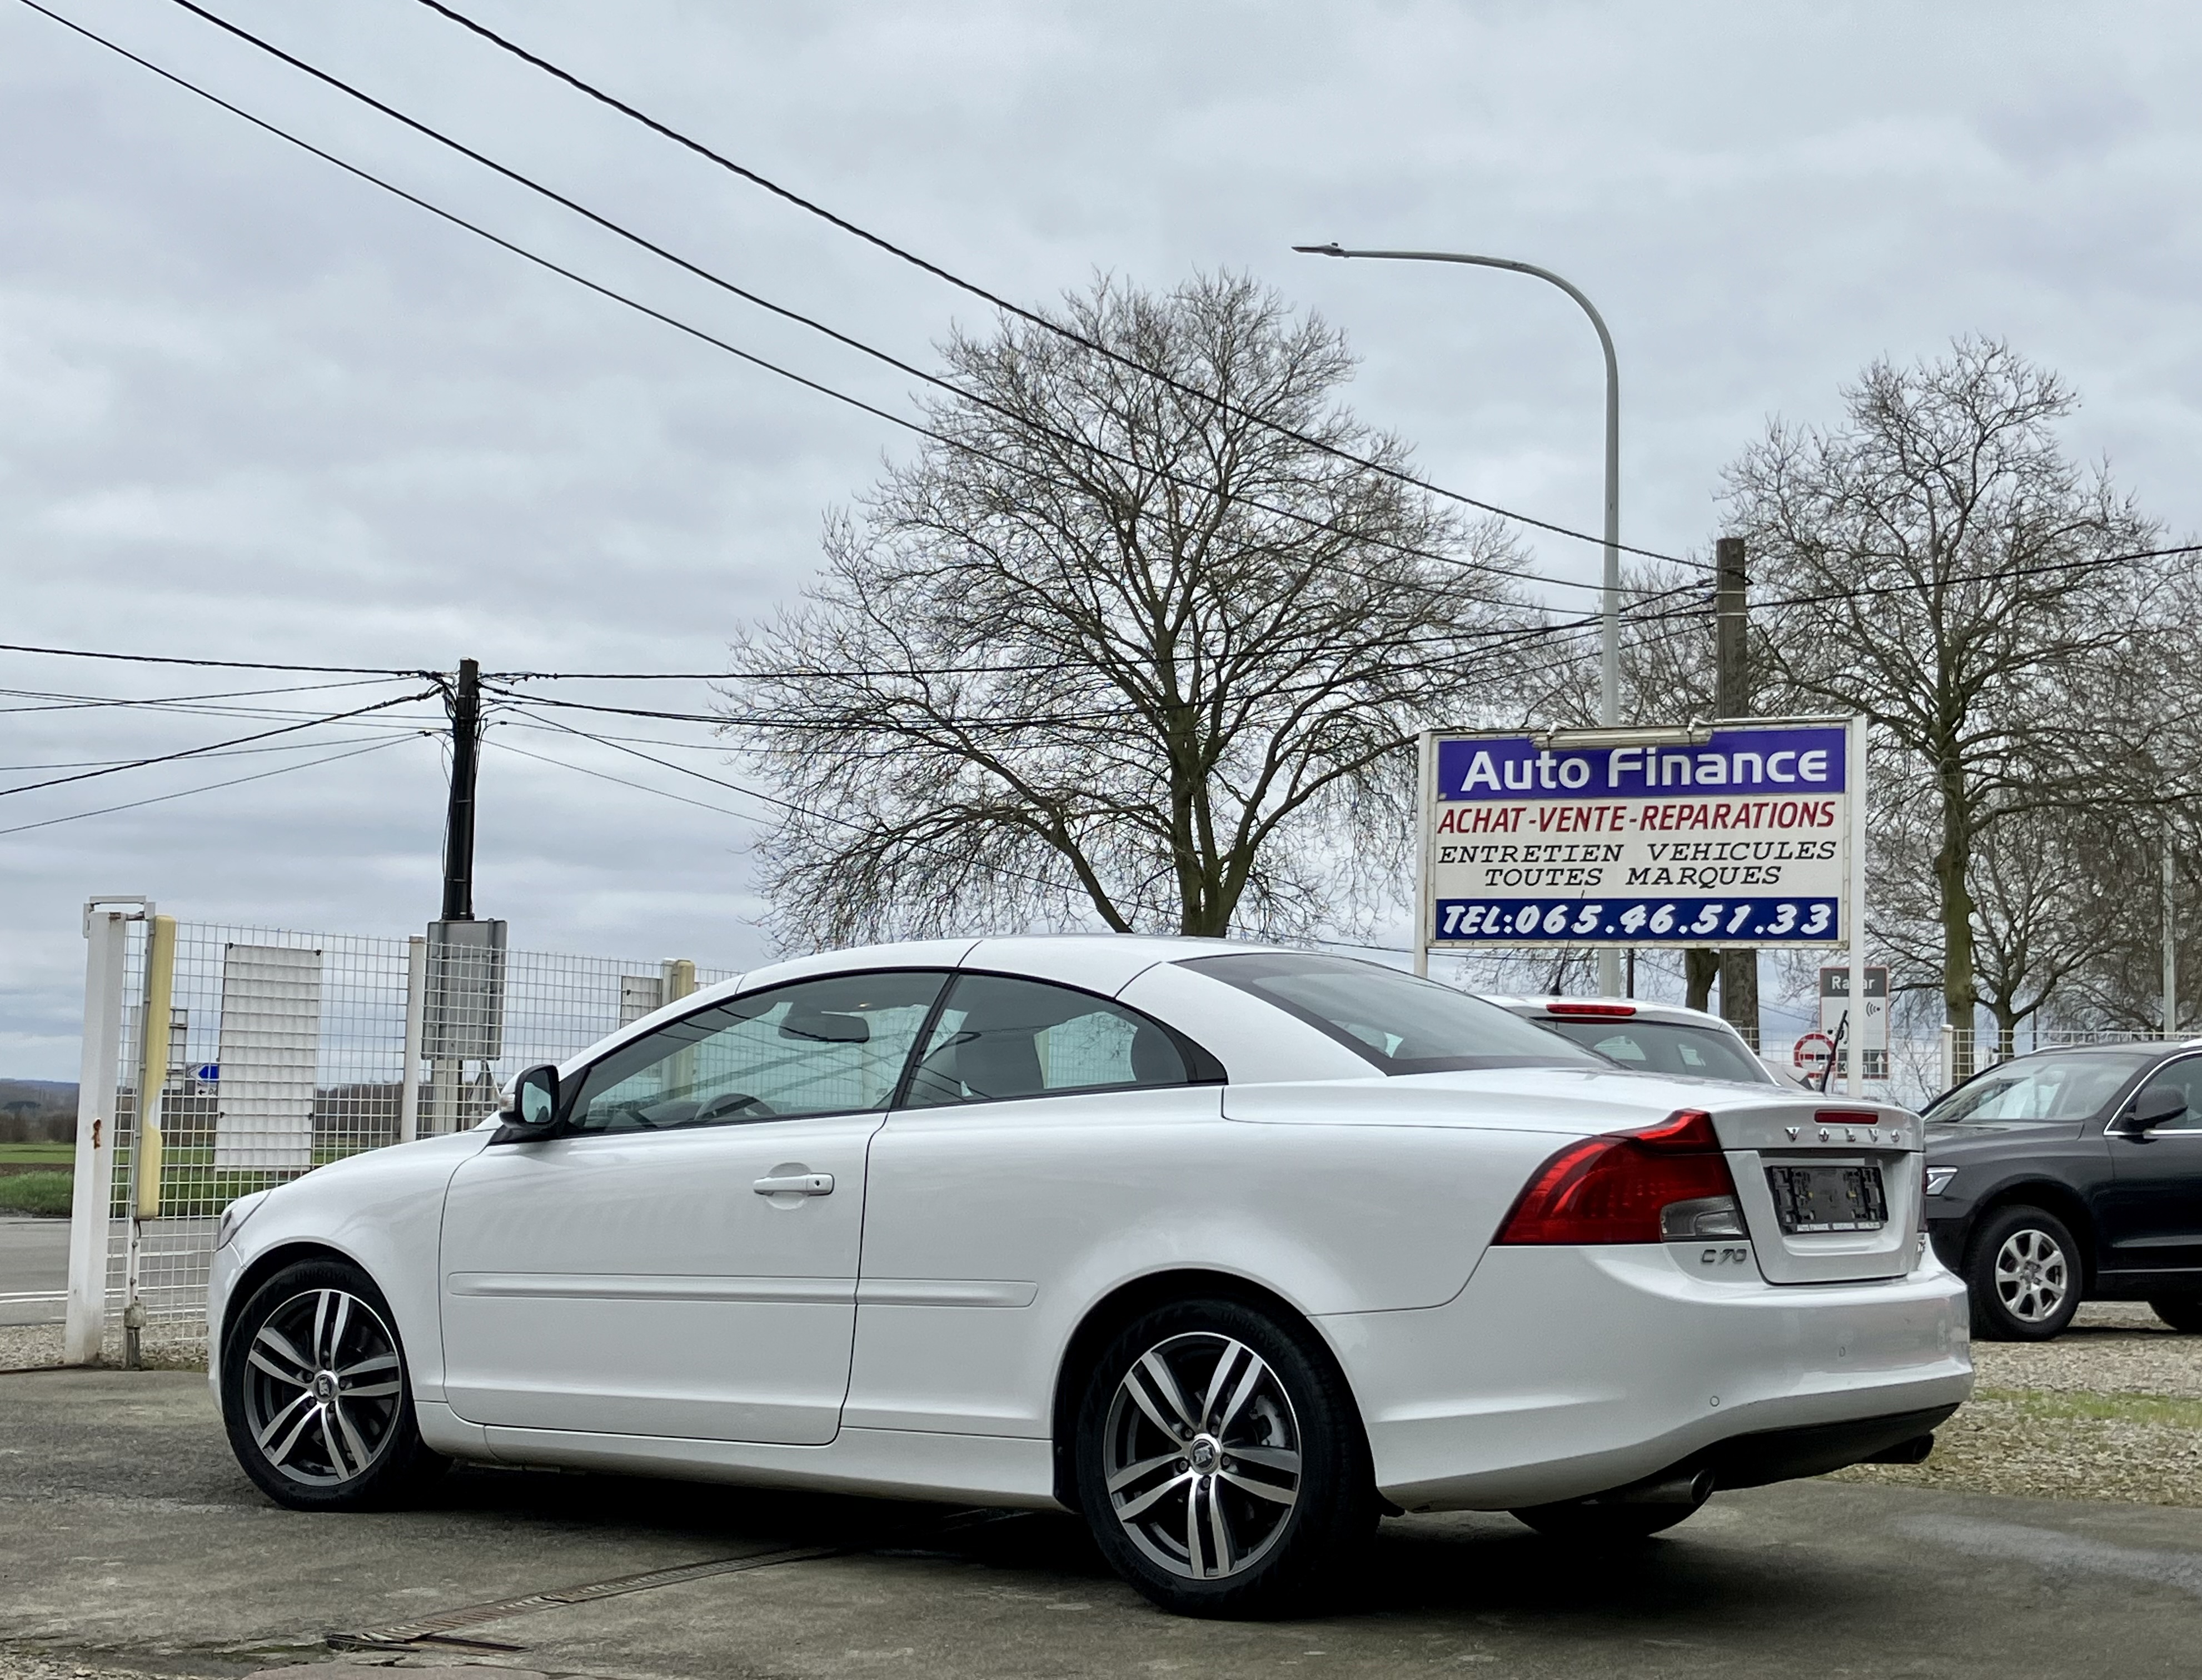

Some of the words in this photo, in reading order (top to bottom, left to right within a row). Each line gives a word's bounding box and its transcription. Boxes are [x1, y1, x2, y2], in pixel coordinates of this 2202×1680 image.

[1459, 750, 1590, 791] Auto
[1608, 746, 1827, 787] Finance
[1437, 844, 1625, 864] ENTRETIEN
[1647, 841, 1837, 862] VEHICULES
[1484, 868, 1603, 886] TOUTES
[1625, 866, 1782, 889] MARQUES
[1831, 975, 1876, 990] Raar
[1785, 1126, 1901, 1142] VOLVO
[1701, 1248, 1747, 1265] C70
